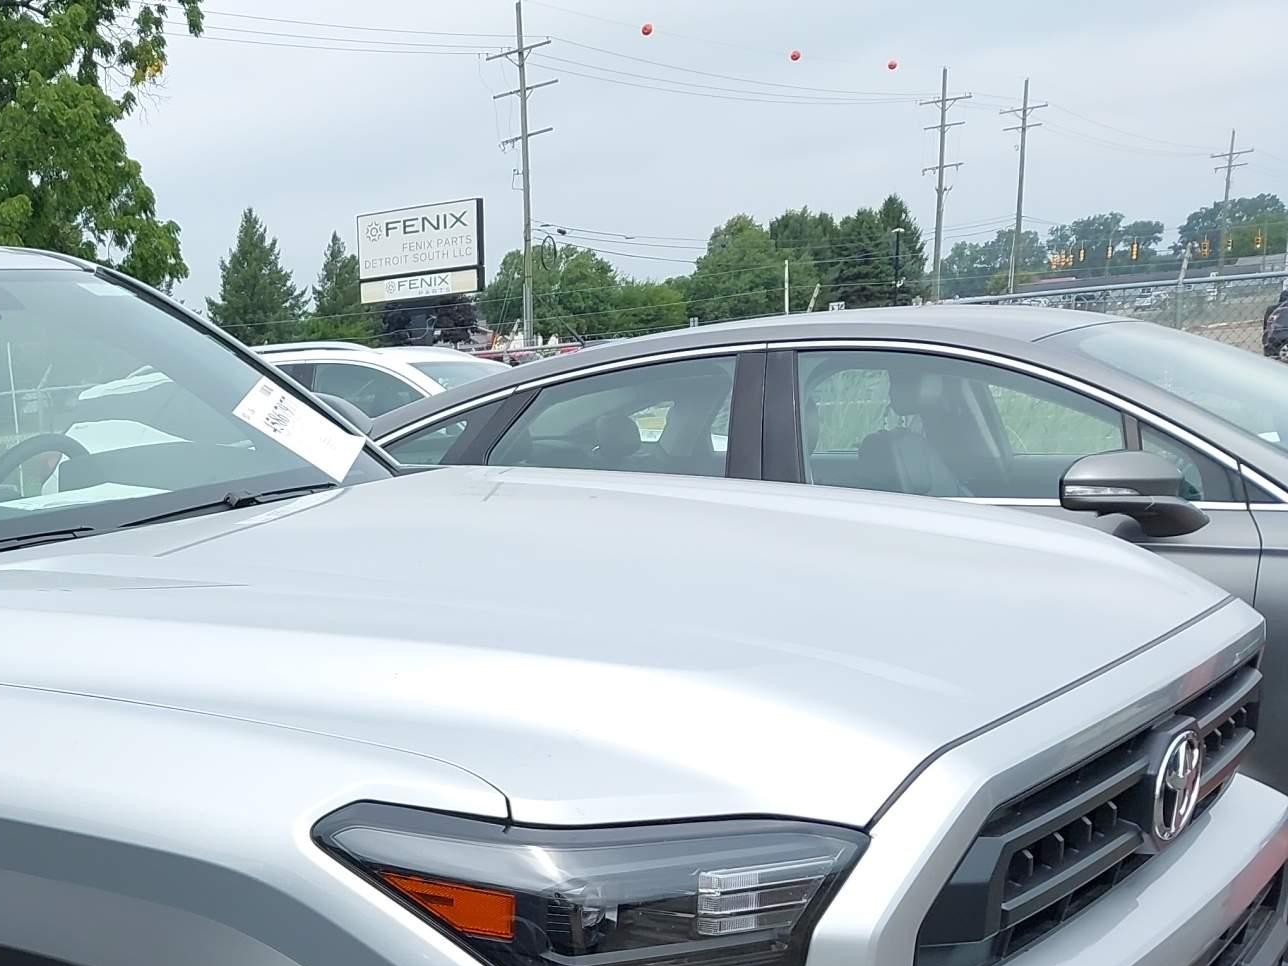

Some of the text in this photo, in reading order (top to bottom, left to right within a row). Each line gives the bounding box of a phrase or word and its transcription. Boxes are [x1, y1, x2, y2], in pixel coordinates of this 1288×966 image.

[385, 210, 468, 237] FENIX
[402, 234, 472, 252] FENIX PARTS
[364, 247, 472, 270] DETROIT SOUTH LLC
[397, 275, 449, 291] FENIX
